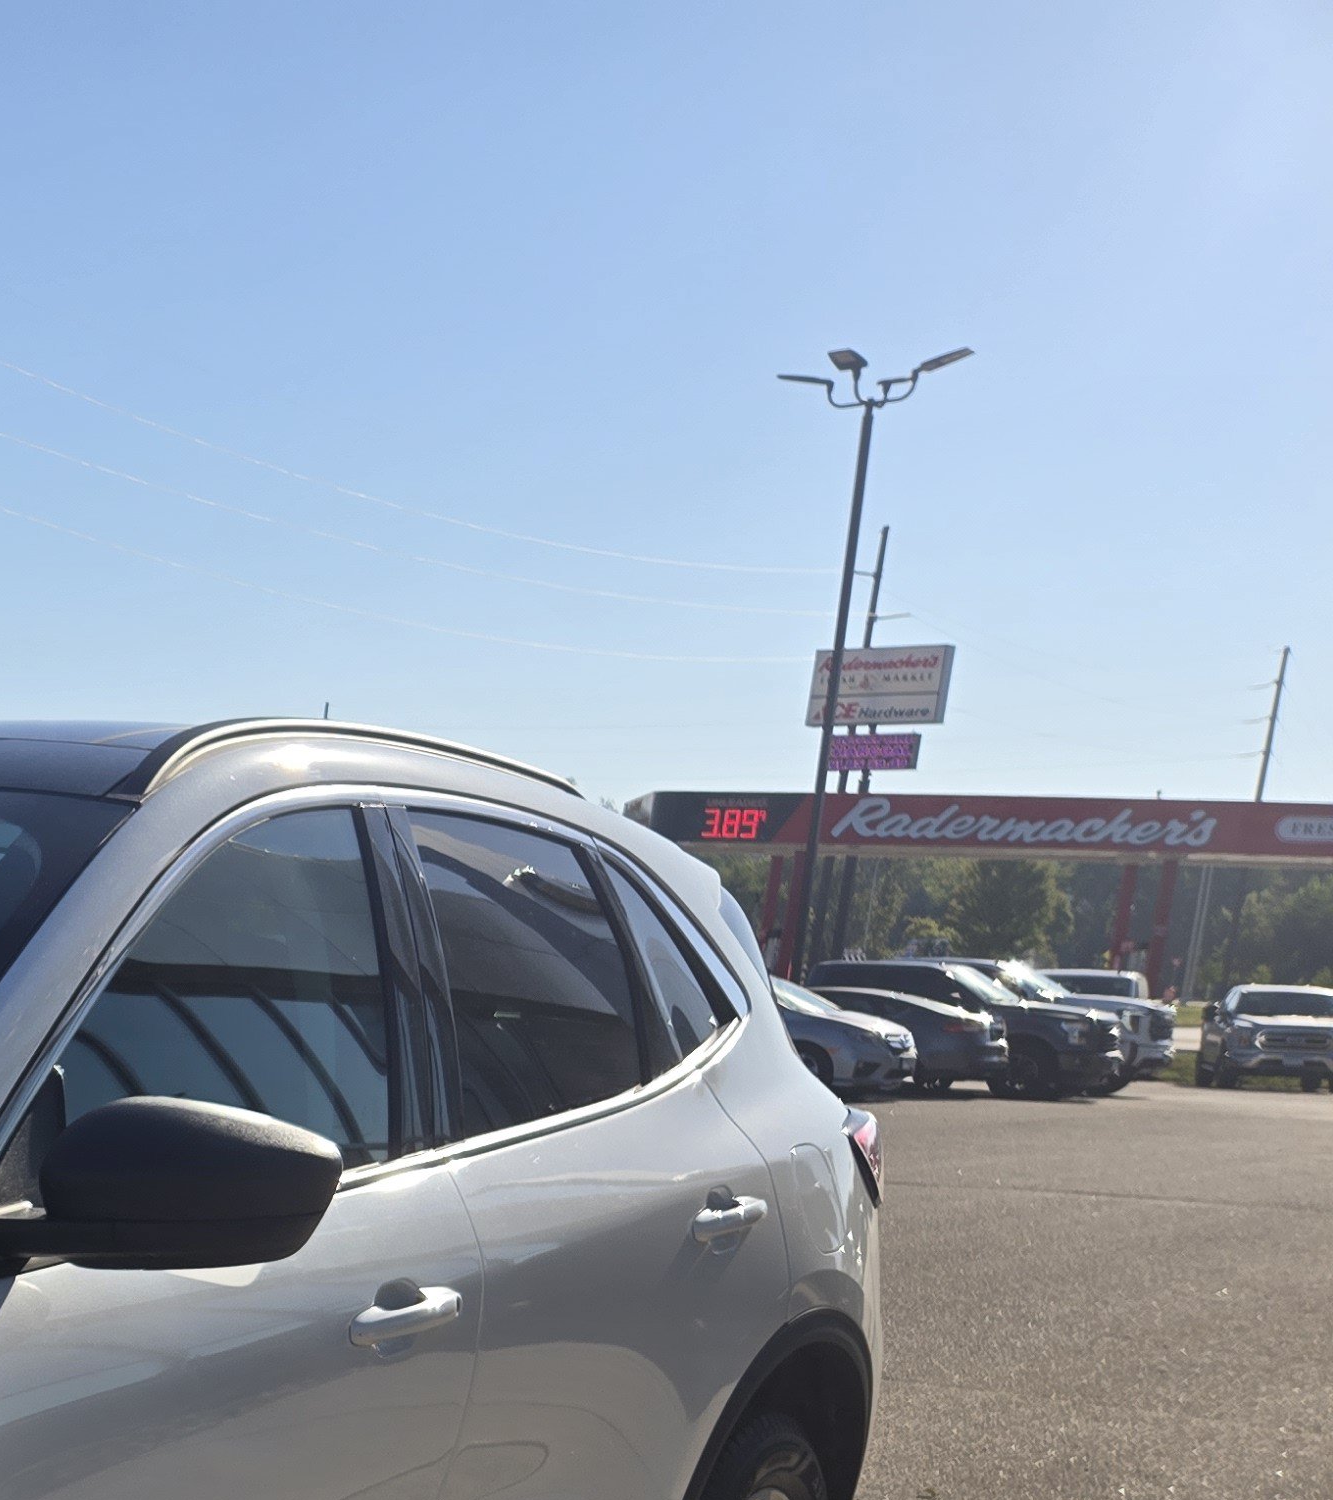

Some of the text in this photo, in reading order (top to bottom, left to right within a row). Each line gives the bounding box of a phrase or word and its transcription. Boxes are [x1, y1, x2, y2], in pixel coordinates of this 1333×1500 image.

[818, 655, 939, 672] Rdermacher's
[859, 706, 930, 719] Hardware
[831, 797, 1218, 847] Radermacher's
